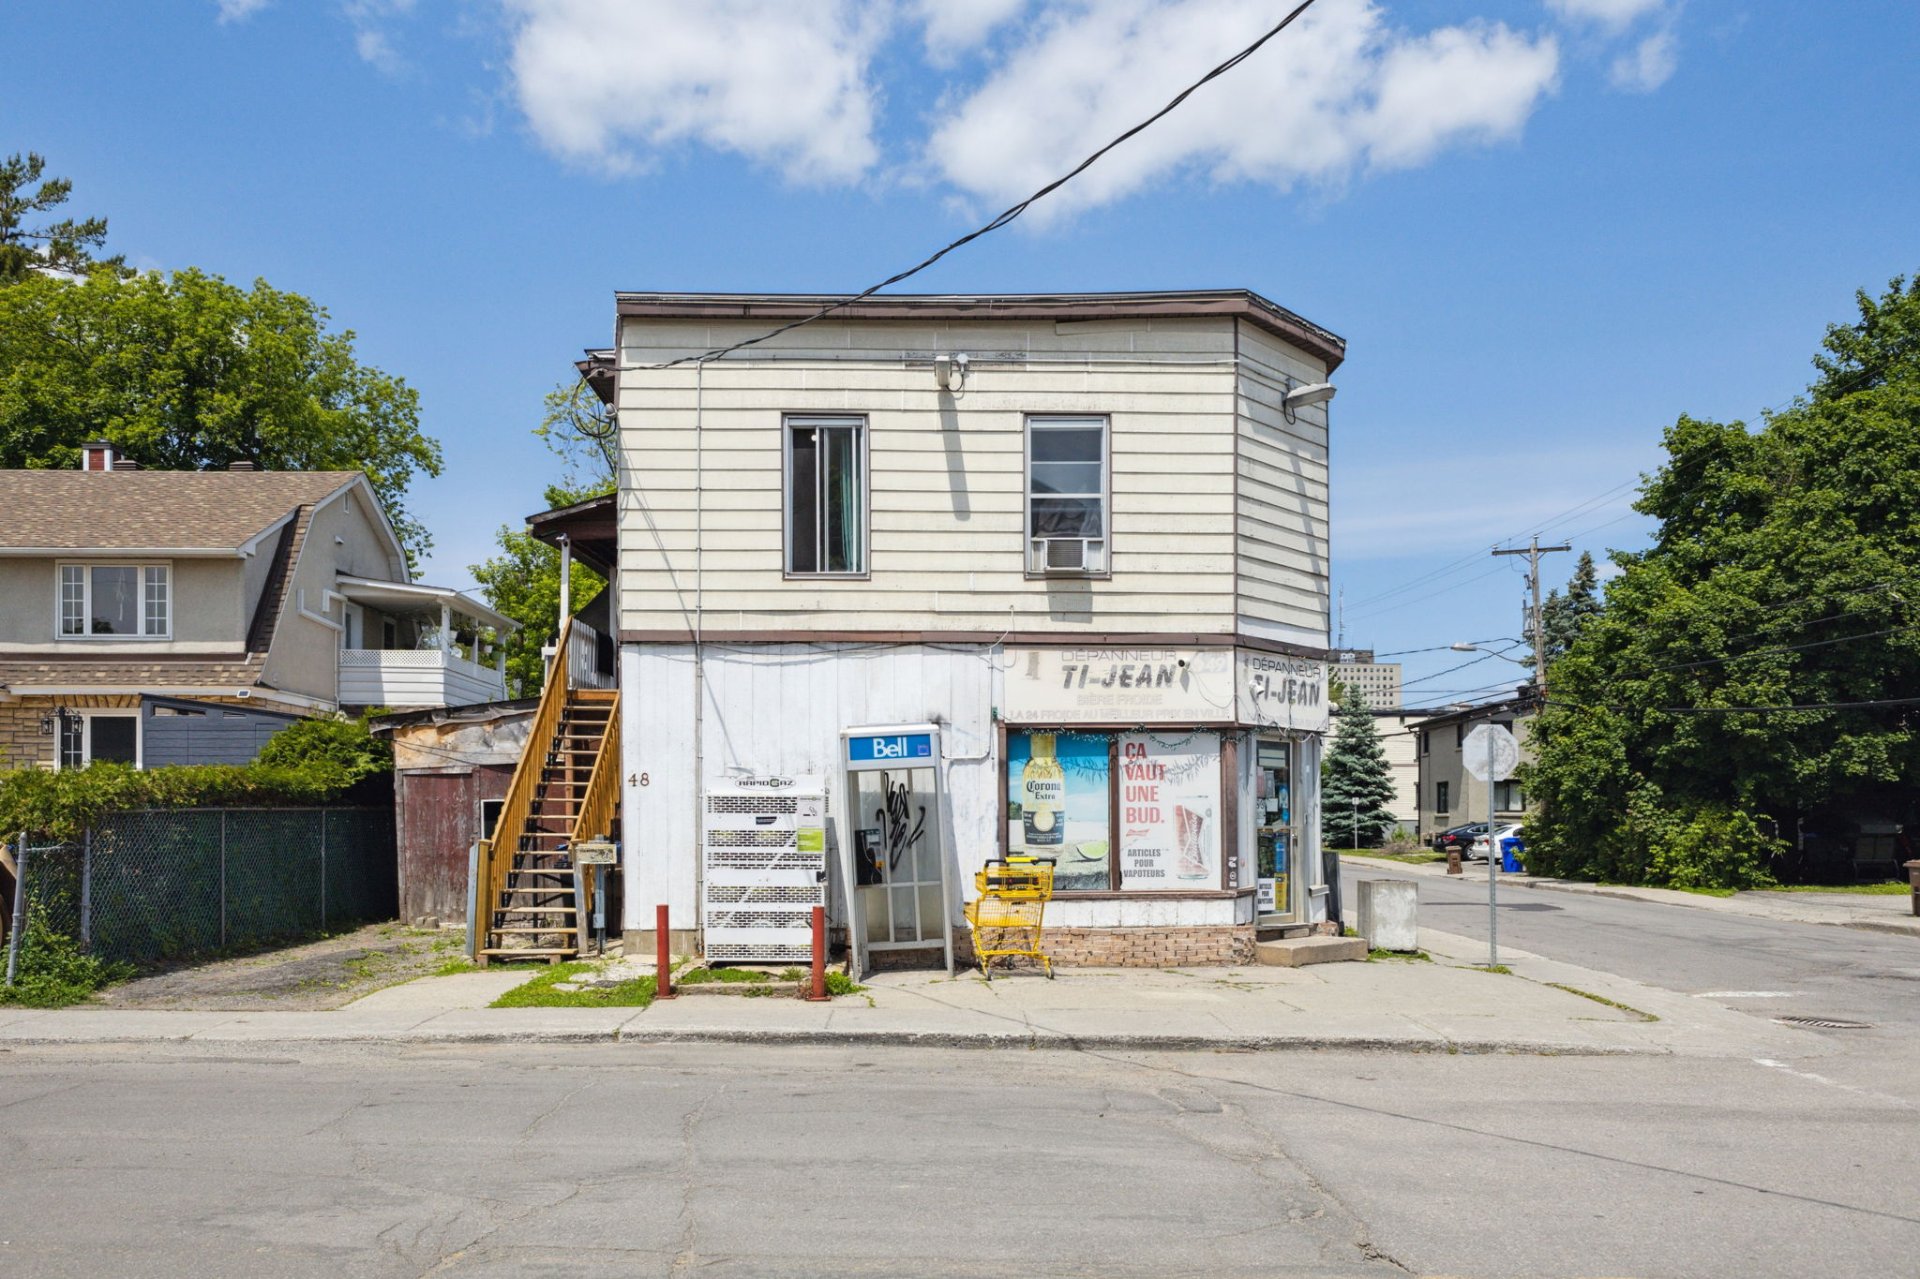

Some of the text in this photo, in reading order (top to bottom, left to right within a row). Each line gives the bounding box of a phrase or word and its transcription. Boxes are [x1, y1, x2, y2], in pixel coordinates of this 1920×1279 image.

[1252, 657, 1321, 679] DÉPANNEUR
[1061, 664, 1177, 689] TI-JEAN
[872, 736, 908, 758] Bell
[627, 772, 650, 787] 48
[1124, 764, 1166, 781] VAUT
[1026, 779, 1062, 795] Corona
[1125, 785, 1159, 802] UNE
[1035, 791, 1056, 800] Extra
[1125, 807, 1165, 824] BUD.
[1127, 849, 1161, 857] ARTICLES
[1134, 859, 1154, 867] POUR
[1123, 869, 1166, 878] VAPOTEURS
